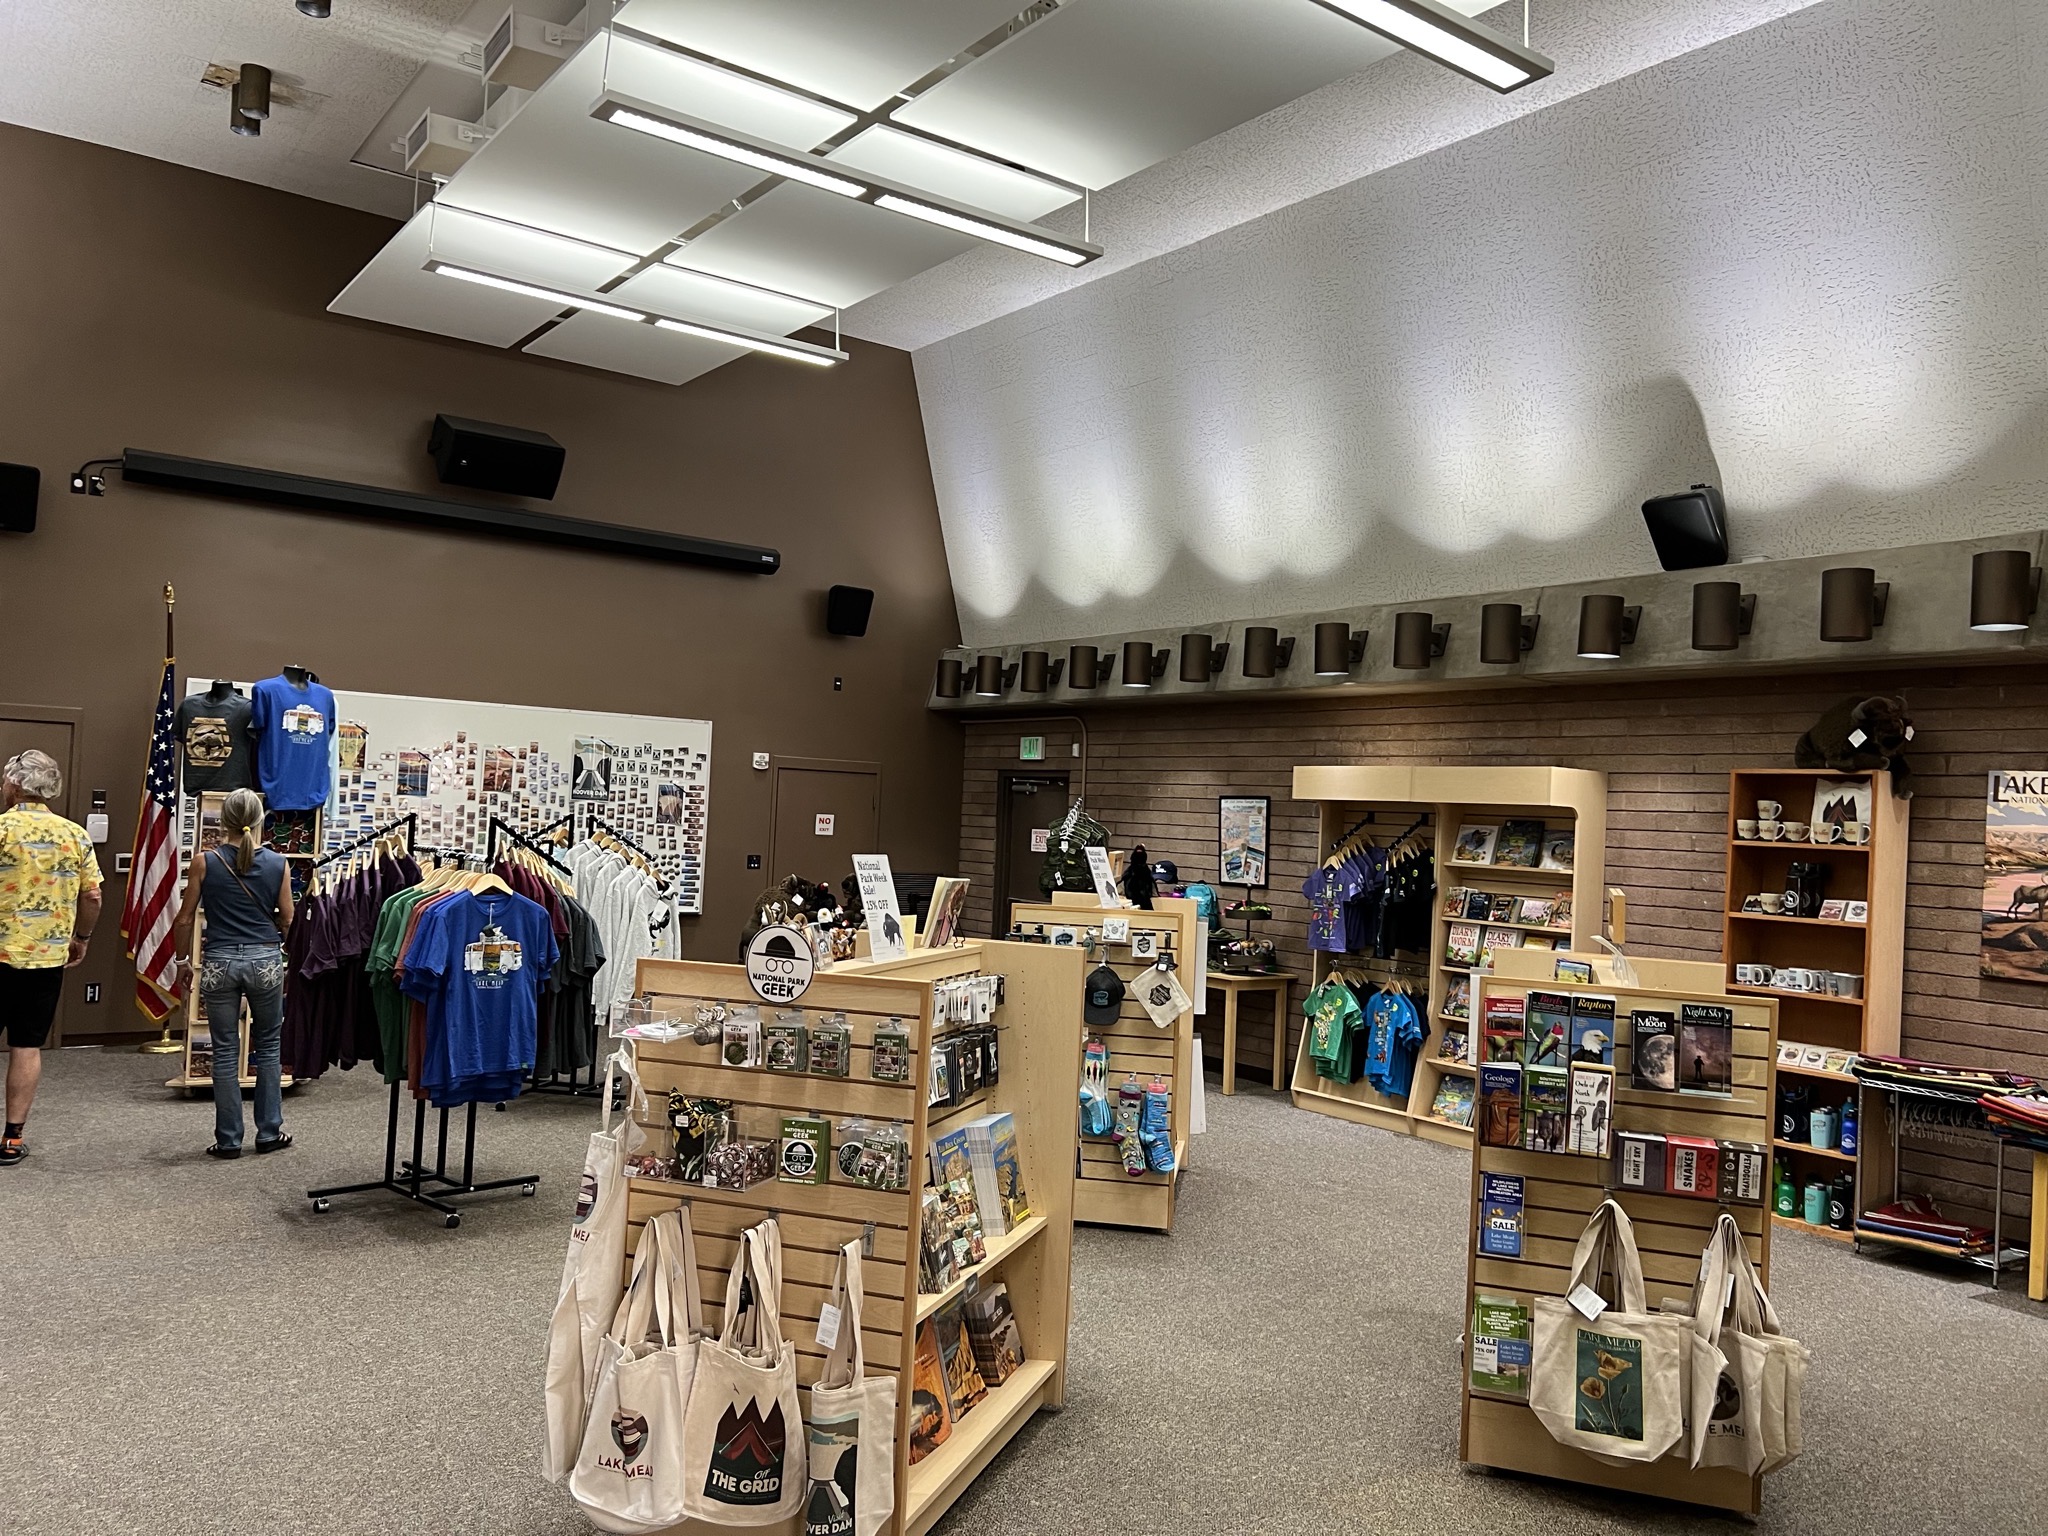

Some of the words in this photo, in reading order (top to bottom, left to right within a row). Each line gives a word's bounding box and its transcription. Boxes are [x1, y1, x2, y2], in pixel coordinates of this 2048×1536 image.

[1023, 738, 1039, 752] EXIT
[572, 789, 594, 797] HOOVER
[1993, 776, 2048, 802] LAKE
[2011, 796, 2048, 804] NATION
[857, 860, 881, 870] National
[860, 873, 874, 882] Park
[874, 873, 888, 882] Week
[863, 886, 876, 895] Sale!
[866, 900, 878, 910] 15%
[878, 900, 888, 910] OFF
[1452, 926, 1474, 938] DIARY
[1487, 931, 1512, 942] DIARY
[1451, 936, 1474, 947] WORM
[752, 972, 786, 984] NATIONAL
[788, 977, 806, 986] PARK
[762, 982, 795, 998] GEEK
[1540, 994, 1563, 1005] Birds
[1578, 998, 1612, 1010] Raptors
[1684, 1006, 1706, 1018] Night
[1708, 1008, 1724, 1019] Sky
[1637, 1018, 1667, 1028] Moon
[1484, 1072, 1515, 1085] Geology
[1574, 1089, 1590, 1097] North
[1574, 1098, 1596, 1107] America
[1634, 1146, 1642, 1158] SKY
[1632, 1161, 1640, 1180] NIGHT
[1682, 1150, 1694, 1188] SNAKES
[1742, 1154, 1752, 1198] PETROGLYPHS
[1492, 1220, 1515, 1230] SALE
[1475, 1336, 1498, 1346] SALE
[1578, 1330, 1603, 1342] LAKE
[1606, 1337, 1640, 1349] MEAD
[598, 1454, 626, 1470] LAKE
[625, 1465, 653, 1479] MEAD
[754, 1468, 770, 1480] Off
[712, 1468, 736, 1492] THE
[740, 1478, 780, 1494] GRID
[828, 1510, 844, 1524] Visit
[832, 1518, 852, 1534] DAM
